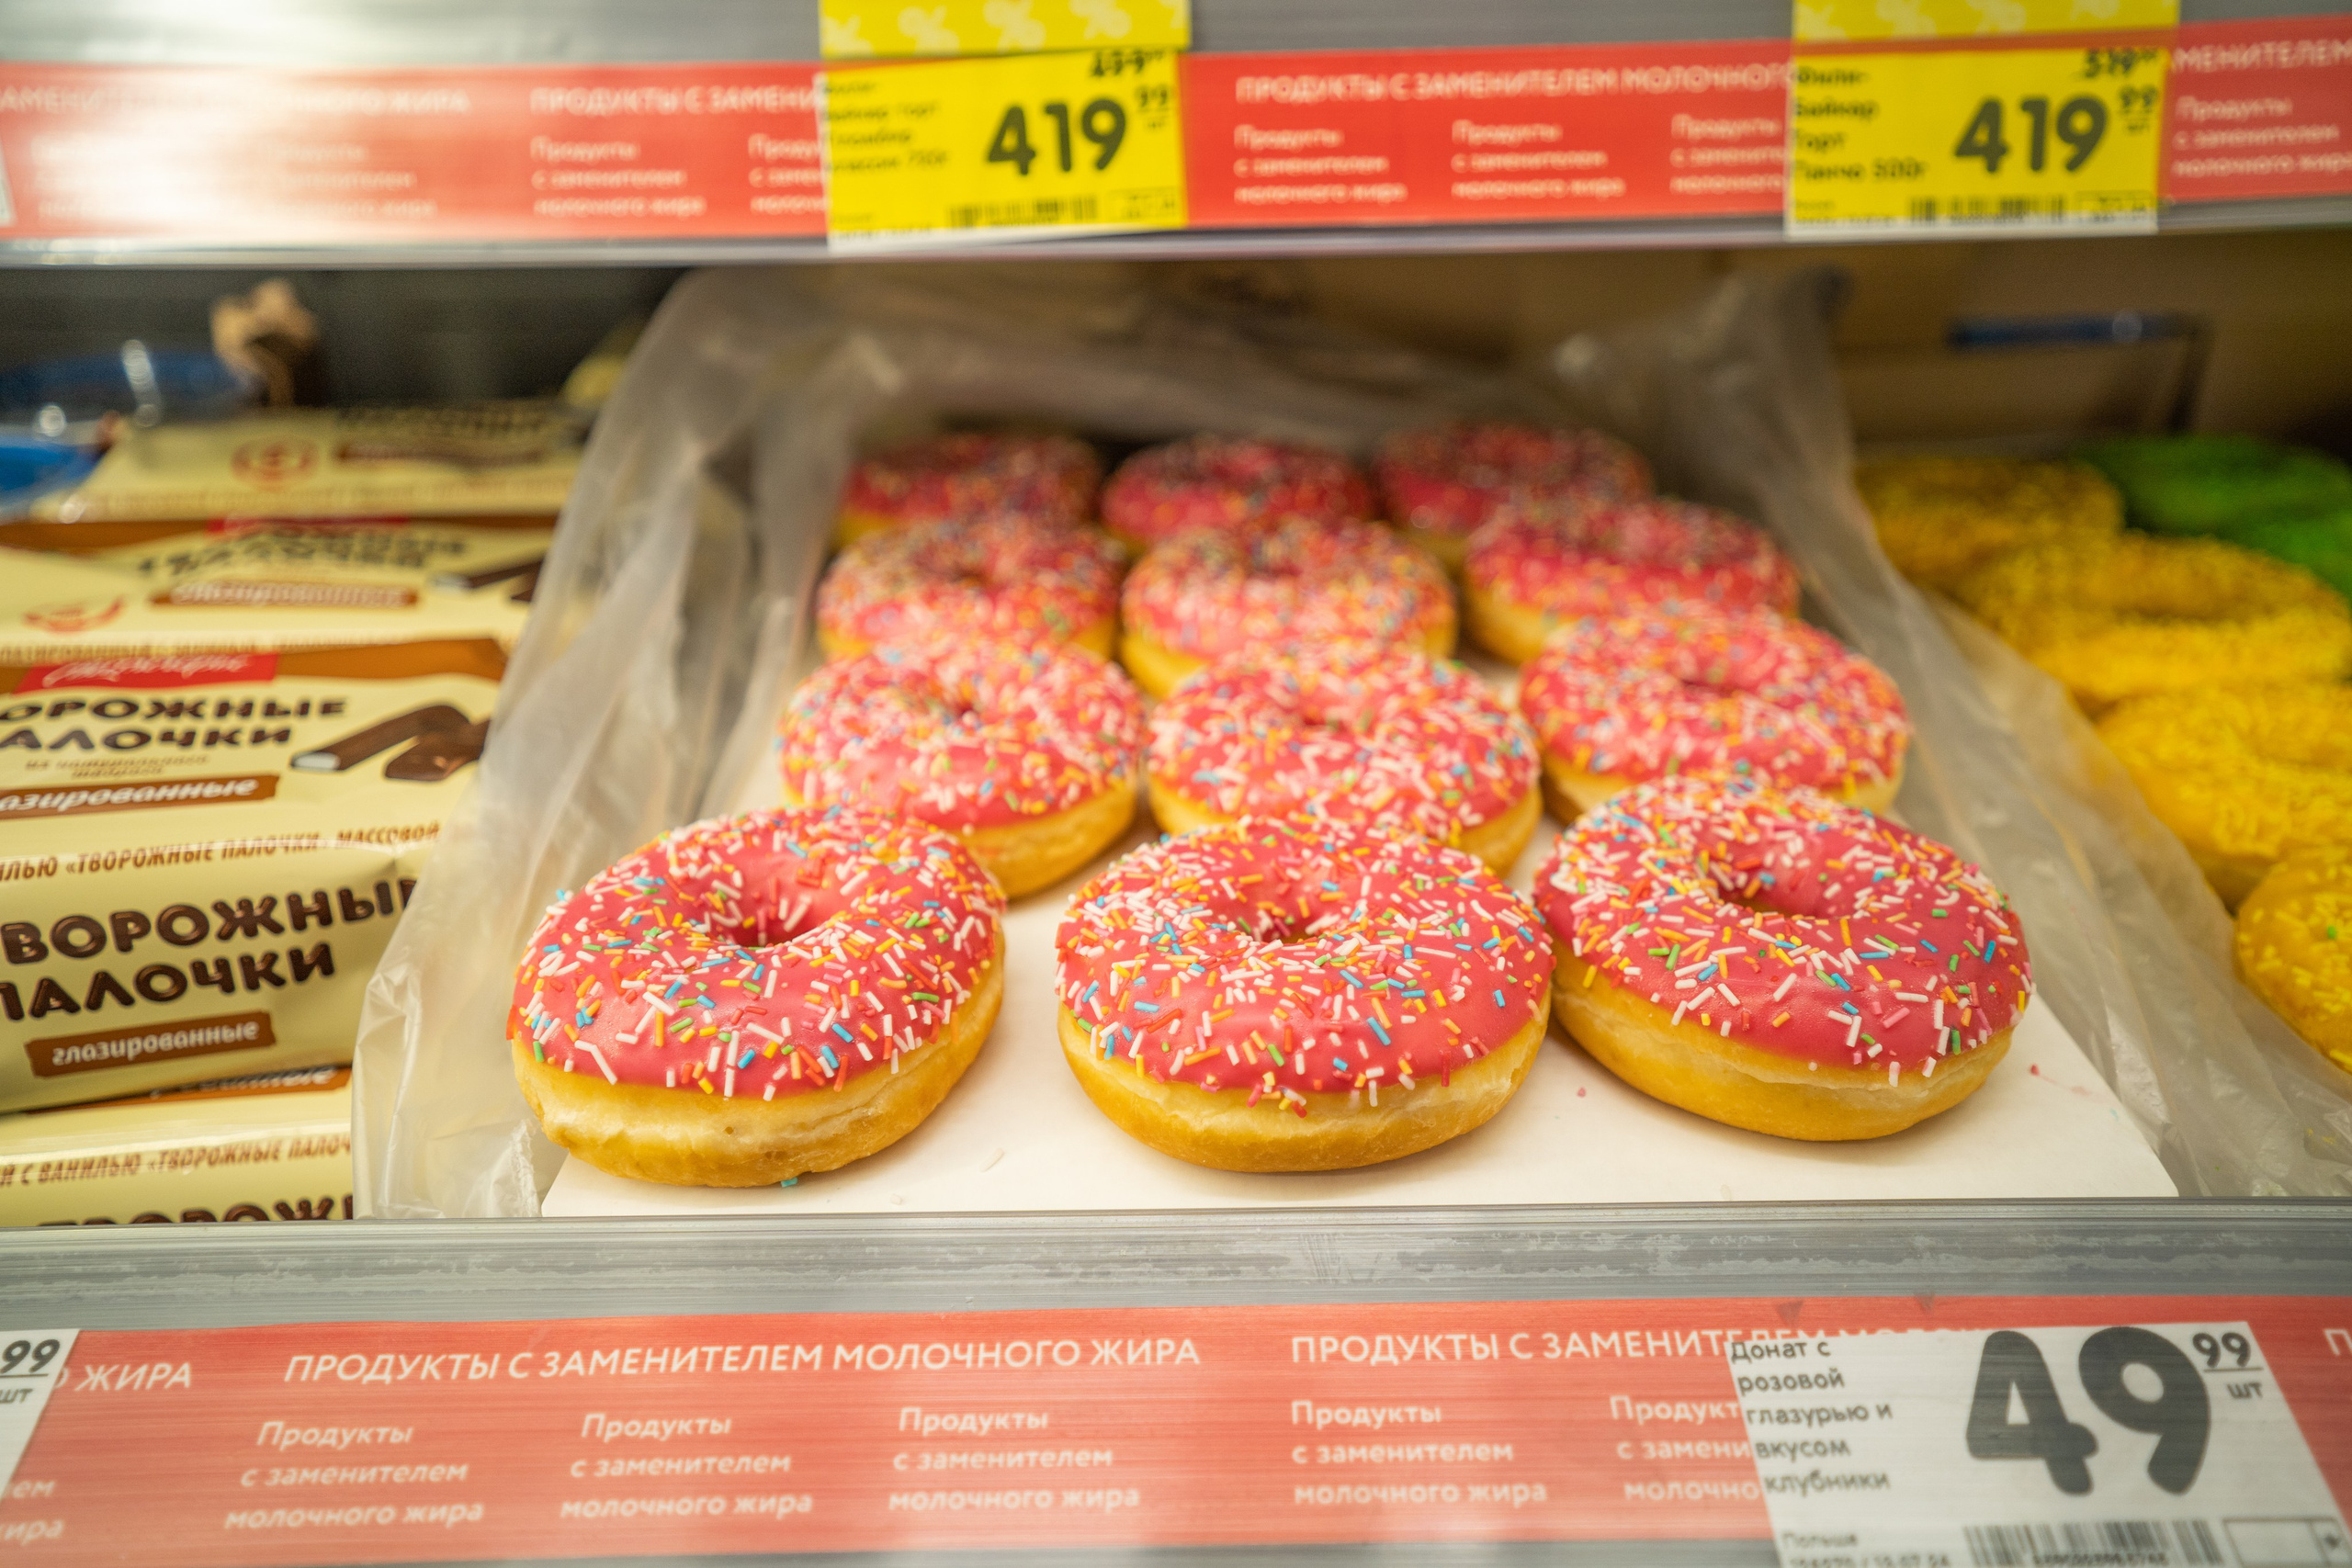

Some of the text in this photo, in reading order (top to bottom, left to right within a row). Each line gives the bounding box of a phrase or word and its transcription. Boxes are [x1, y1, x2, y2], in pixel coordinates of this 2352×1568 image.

[711, 85, 818, 113] ЗАМЕНИ
[1236, 74, 1388, 105] ПРОДУКТЫ
[1390, 73, 1413, 101] С
[1415, 69, 1618, 100] ЗАМЕНИТЕЛЕМ
[2176, 96, 2292, 122] Продукты
[988, 85, 1171, 175] 419 99
[1953, 85, 2157, 174] 419 99
[65, 840, 213, 875] «ТВОРОЖНЫЕ
[51, 1020, 260, 1066] глазированные
[38, 1152, 141, 1184] ВАНИЛЬЮ
[0, 1338, 61, 1374] 99
[284, 1337, 1201, 1384] ПРОДУКТЫ С ЗАМЕНИТЕЛЕМ МОЛОЧНОГО ЖИРА
[1291, 1333, 1500, 1366] ПРОДУКТЫ
[1510, 1331, 1533, 1360] С
[1730, 1341, 1831, 1363] Донат с
[74, 1362, 192, 1392] ЖИРА
[1737, 1368, 1845, 1397] розовой
[2227, 1382, 2263, 1399] шт
[898, 1406, 1049, 1436] Продукты
[1291, 1399, 1442, 1429] Продукты
[1746, 1403, 1893, 1428] глазурью и
[1965, 1325, 2251, 1496] 49 99
[255, 1420, 414, 1451] Продукты
[581, 1412, 732, 1443] Продукты
[570, 1451, 792, 1479] с заменителем
[892, 1446, 1114, 1472] с заменителем
[1292, 1442, 1515, 1464] с заменителем
[1617, 1440, 1634, 1461] с
[1755, 1439, 1851, 1461] вкусом
[240, 1461, 469, 1488] с заменителем
[1764, 1471, 1890, 1497] клубники
[560, 1491, 814, 1521] молочного жира
[888, 1486, 1141, 1516] молочного жира
[1294, 1481, 1548, 1509] молочного жира
[223, 1500, 485, 1531] молочного жира
